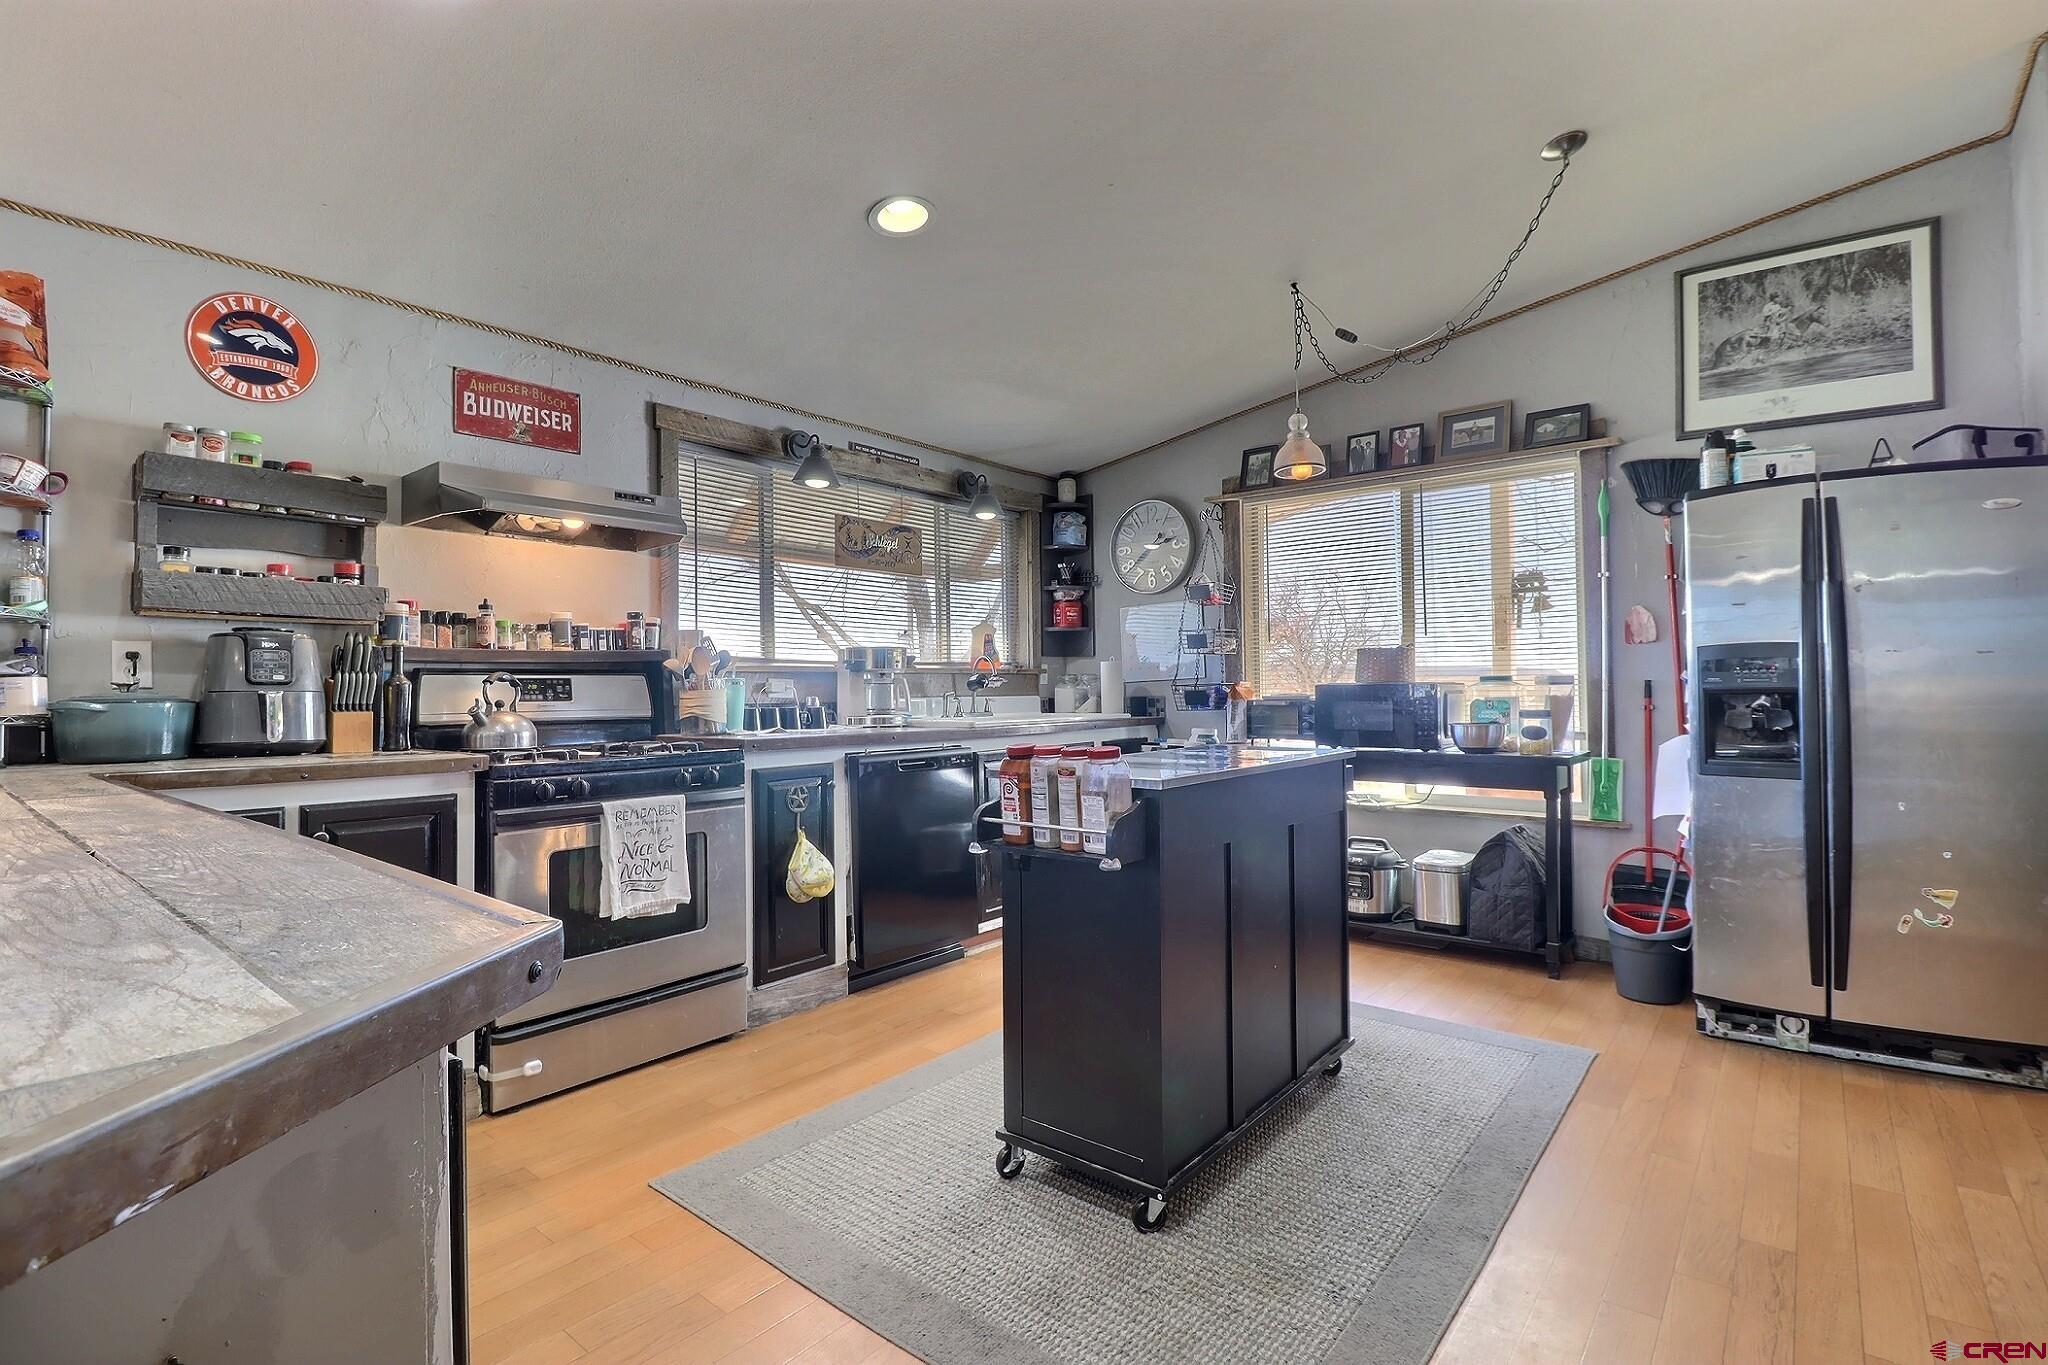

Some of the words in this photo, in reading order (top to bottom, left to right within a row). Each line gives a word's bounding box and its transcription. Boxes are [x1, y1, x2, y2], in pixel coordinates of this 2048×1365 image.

[213, 297, 296, 329] DENVER
[220, 354, 268, 368] ESTABLISHED
[209, 367, 300, 399] BRONCOS
[1146, 505, 1163, 525] 12
[1117, 546, 1132, 556] 9
[1172, 538, 1188, 549] 3
[1121, 559, 1135, 573] 8
[1169, 554, 1185, 568] 4
[1133, 567, 1145, 584] 7
[1148, 568, 1157, 588] 6
[1160, 565, 1173, 583] 5
[615, 804, 678, 823] REMEMBER
[620, 855, 677, 880] NORMAL
